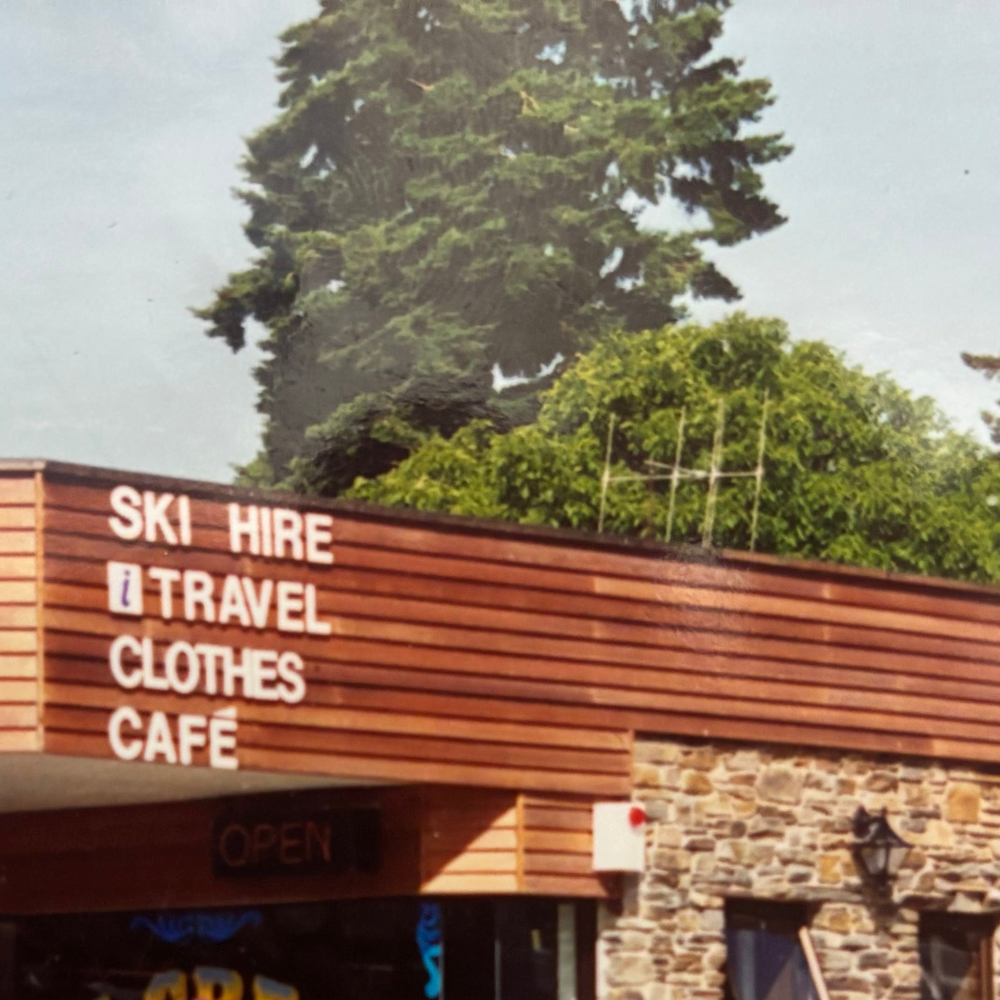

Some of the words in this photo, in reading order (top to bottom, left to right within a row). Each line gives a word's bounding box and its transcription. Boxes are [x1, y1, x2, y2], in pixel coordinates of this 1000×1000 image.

[108, 485, 192, 546] SKI
[227, 502, 335, 565] HIRE
[147, 566, 333, 635] TRAVEL
[109, 634, 307, 704] CLOTHES
[107, 705, 239, 770] CAFÉ
[219, 821, 332, 867] OPEN
